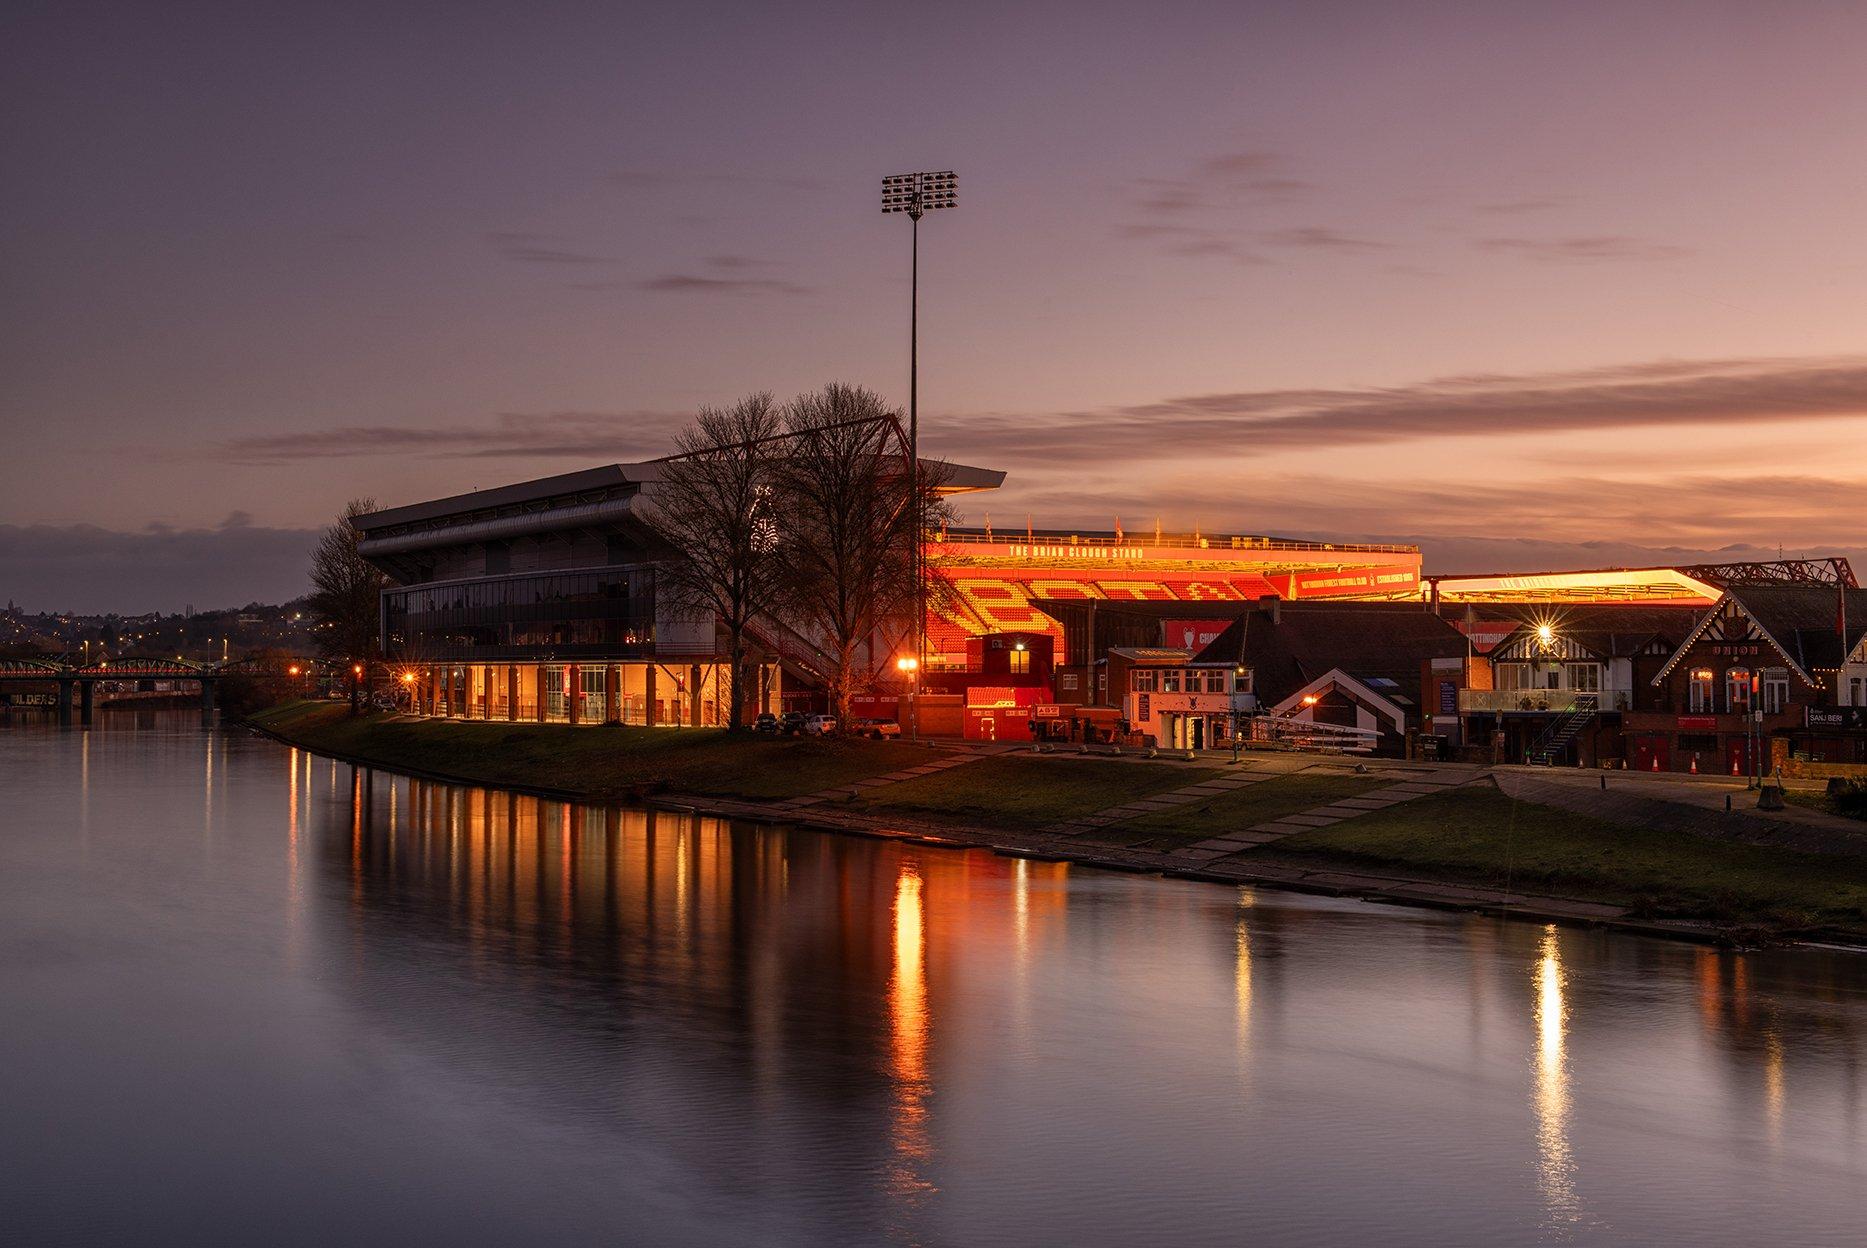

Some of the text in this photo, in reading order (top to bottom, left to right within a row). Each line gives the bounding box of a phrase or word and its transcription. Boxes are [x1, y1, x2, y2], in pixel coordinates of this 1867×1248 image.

[1009, 545, 1143, 558] THE BRIAN CLOUGH STAND
[1711, 646, 1759, 656] UNION
[1809, 714, 1843, 722] SANJ BERI
